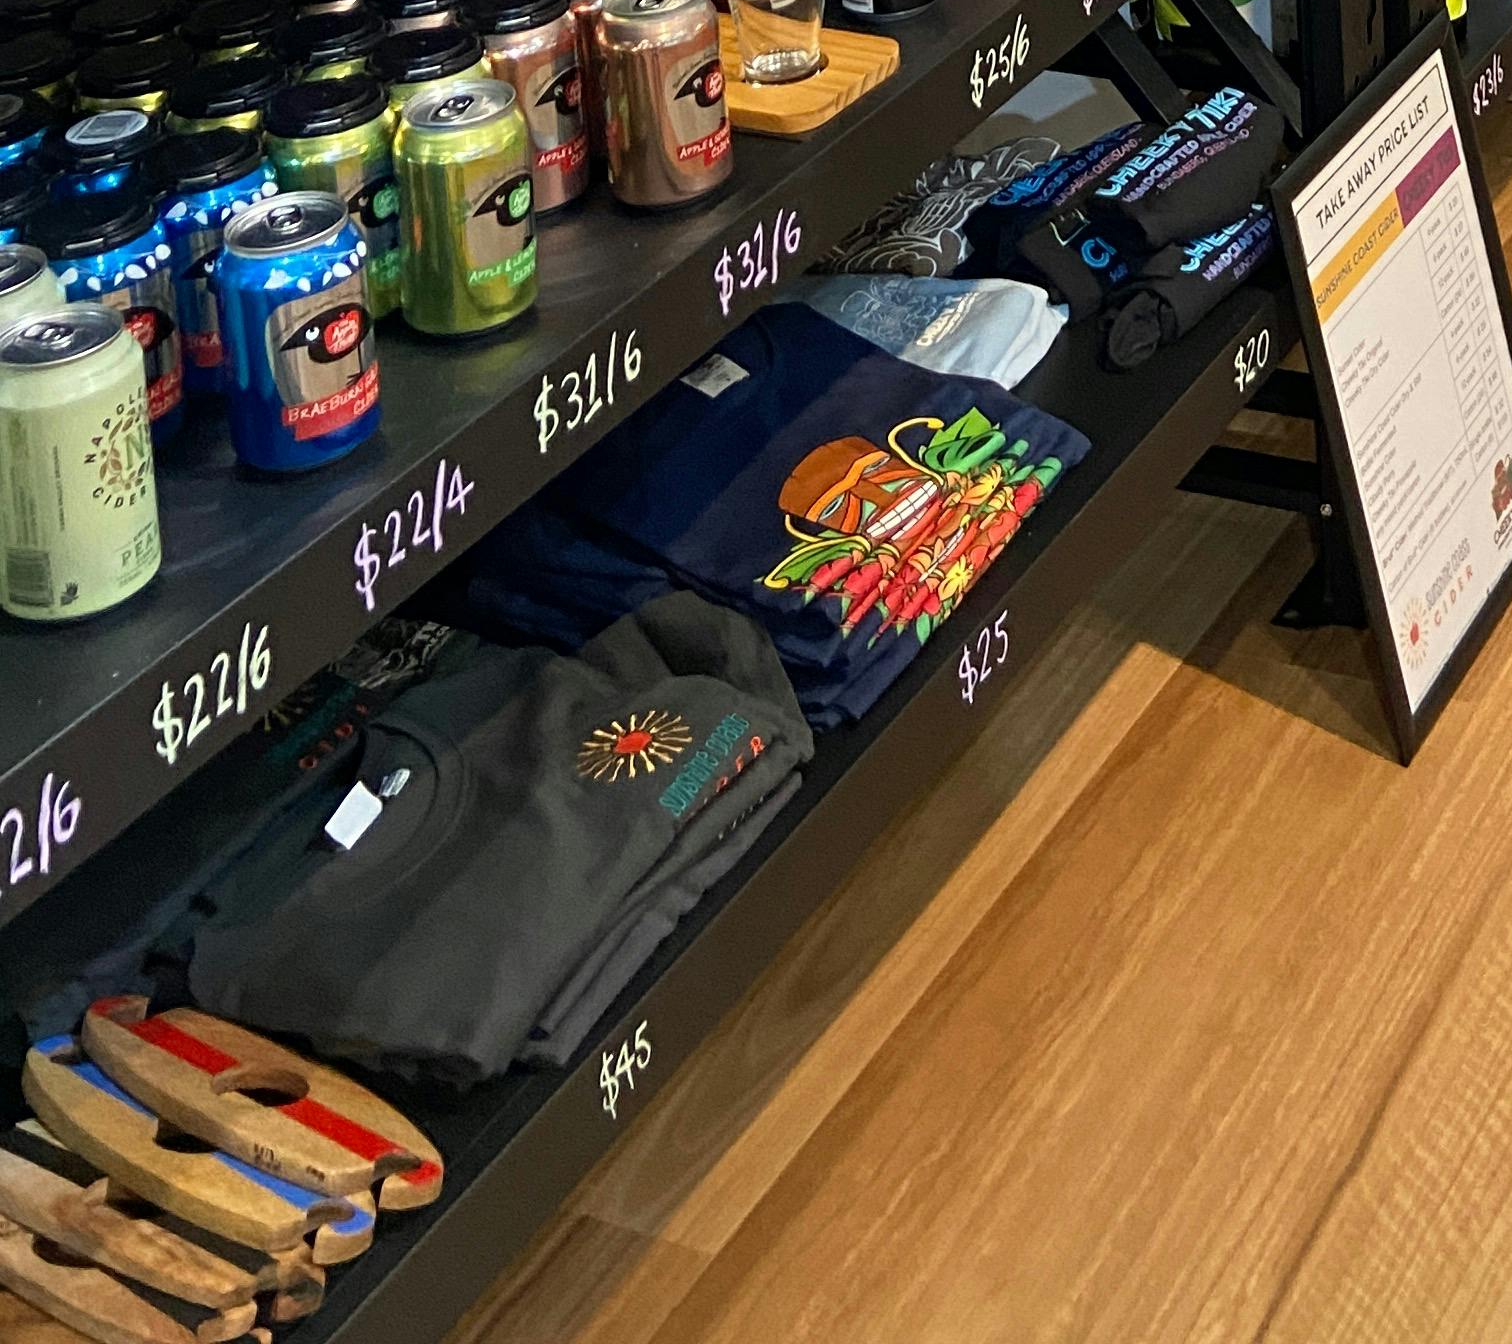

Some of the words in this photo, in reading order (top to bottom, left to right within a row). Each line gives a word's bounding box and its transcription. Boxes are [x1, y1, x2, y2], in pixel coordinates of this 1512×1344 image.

[970, 13, 1030, 109] $25/6
[1472, 52, 1504, 116] $23/6
[679, 141, 708, 160] APPLE
[1095, 119, 1194, 198] CHEEKY
[1185, 86, 1246, 130] TIKI
[1122, 139, 1200, 203] HANDCRAFTED
[1315, 193, 1346, 230] TAKE
[1347, 153, 1378, 202] AWAY
[1378, 120, 1409, 167] PRICE
[1408, 95, 1430, 130] LIST
[468, 265, 502, 284] APPLE
[713, 207, 801, 316] $31/6
[1179, 215, 1248, 273] CHEE
[1315, 257, 1354, 309] SUNSHINE
[1352, 231, 1378, 267] COAST
[533, 328, 643, 454] $31/6
[1233, 328, 1271, 393] $20
[92, 485, 147, 510] CIDER
[353, 458, 475, 612] $22/4
[1433, 564, 1474, 628] CIDER
[151, 621, 271, 765] $22/6
[957, 609, 1009, 704] $25
[599, 1019, 652, 1120] $45
